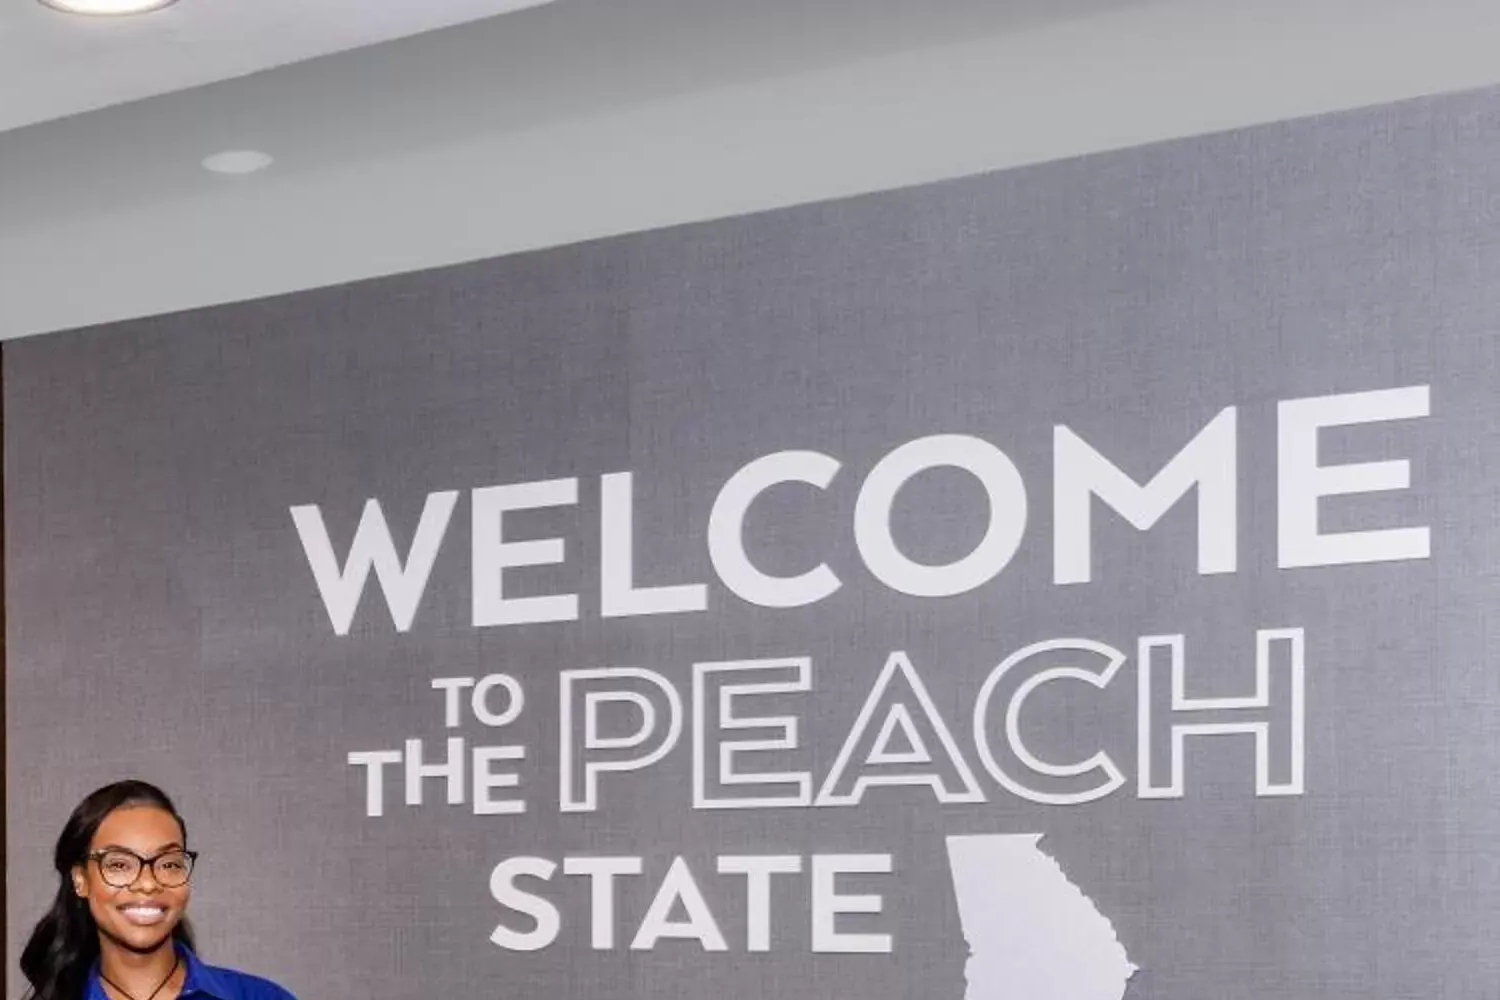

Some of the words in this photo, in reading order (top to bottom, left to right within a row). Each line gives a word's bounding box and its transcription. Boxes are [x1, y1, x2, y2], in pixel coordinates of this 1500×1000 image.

[289, 384, 1431, 637] WELCOME
[348, 737, 526, 817] THE
[559, 627, 1306, 812] PEACH
[431, 673, 525, 727] TO
[489, 853, 893, 954] STATE
